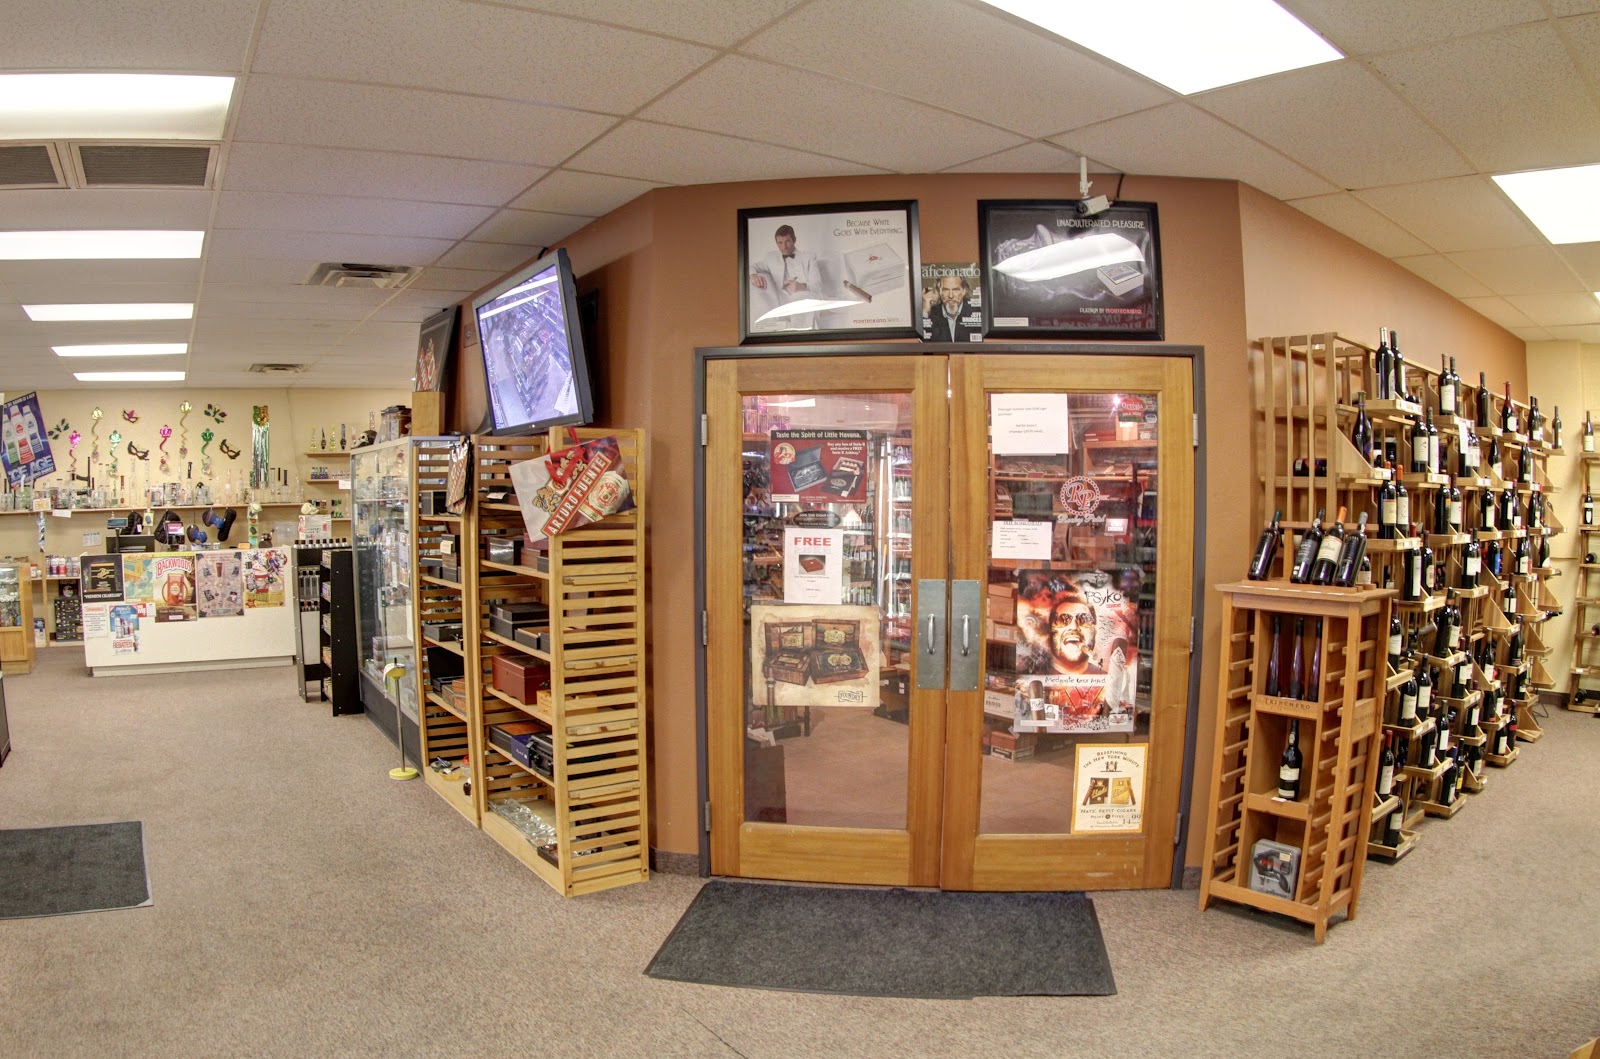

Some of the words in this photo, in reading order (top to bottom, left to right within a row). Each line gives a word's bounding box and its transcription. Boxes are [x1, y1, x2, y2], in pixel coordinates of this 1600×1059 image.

[846, 219, 871, 227] BECAUSE
[873, 218, 890, 226] WHITE
[1056, 219, 1110, 228] UNADULTERATED
[1112, 219, 1145, 229] PLEASURE.
[833, 228, 852, 237] GOES
[922, 263, 981, 278] aficionado
[547, 494, 579, 535] ARTURO
[574, 457, 607, 497] FUENTE
[794, 537, 832, 546] FREE
[156, 557, 192, 577] BACKWOODS
[1264, 697, 1311, 710] TRINCHERO
[1083, 761, 1092, 769] THE
[1122, 756, 1140, 768] MINUTE
